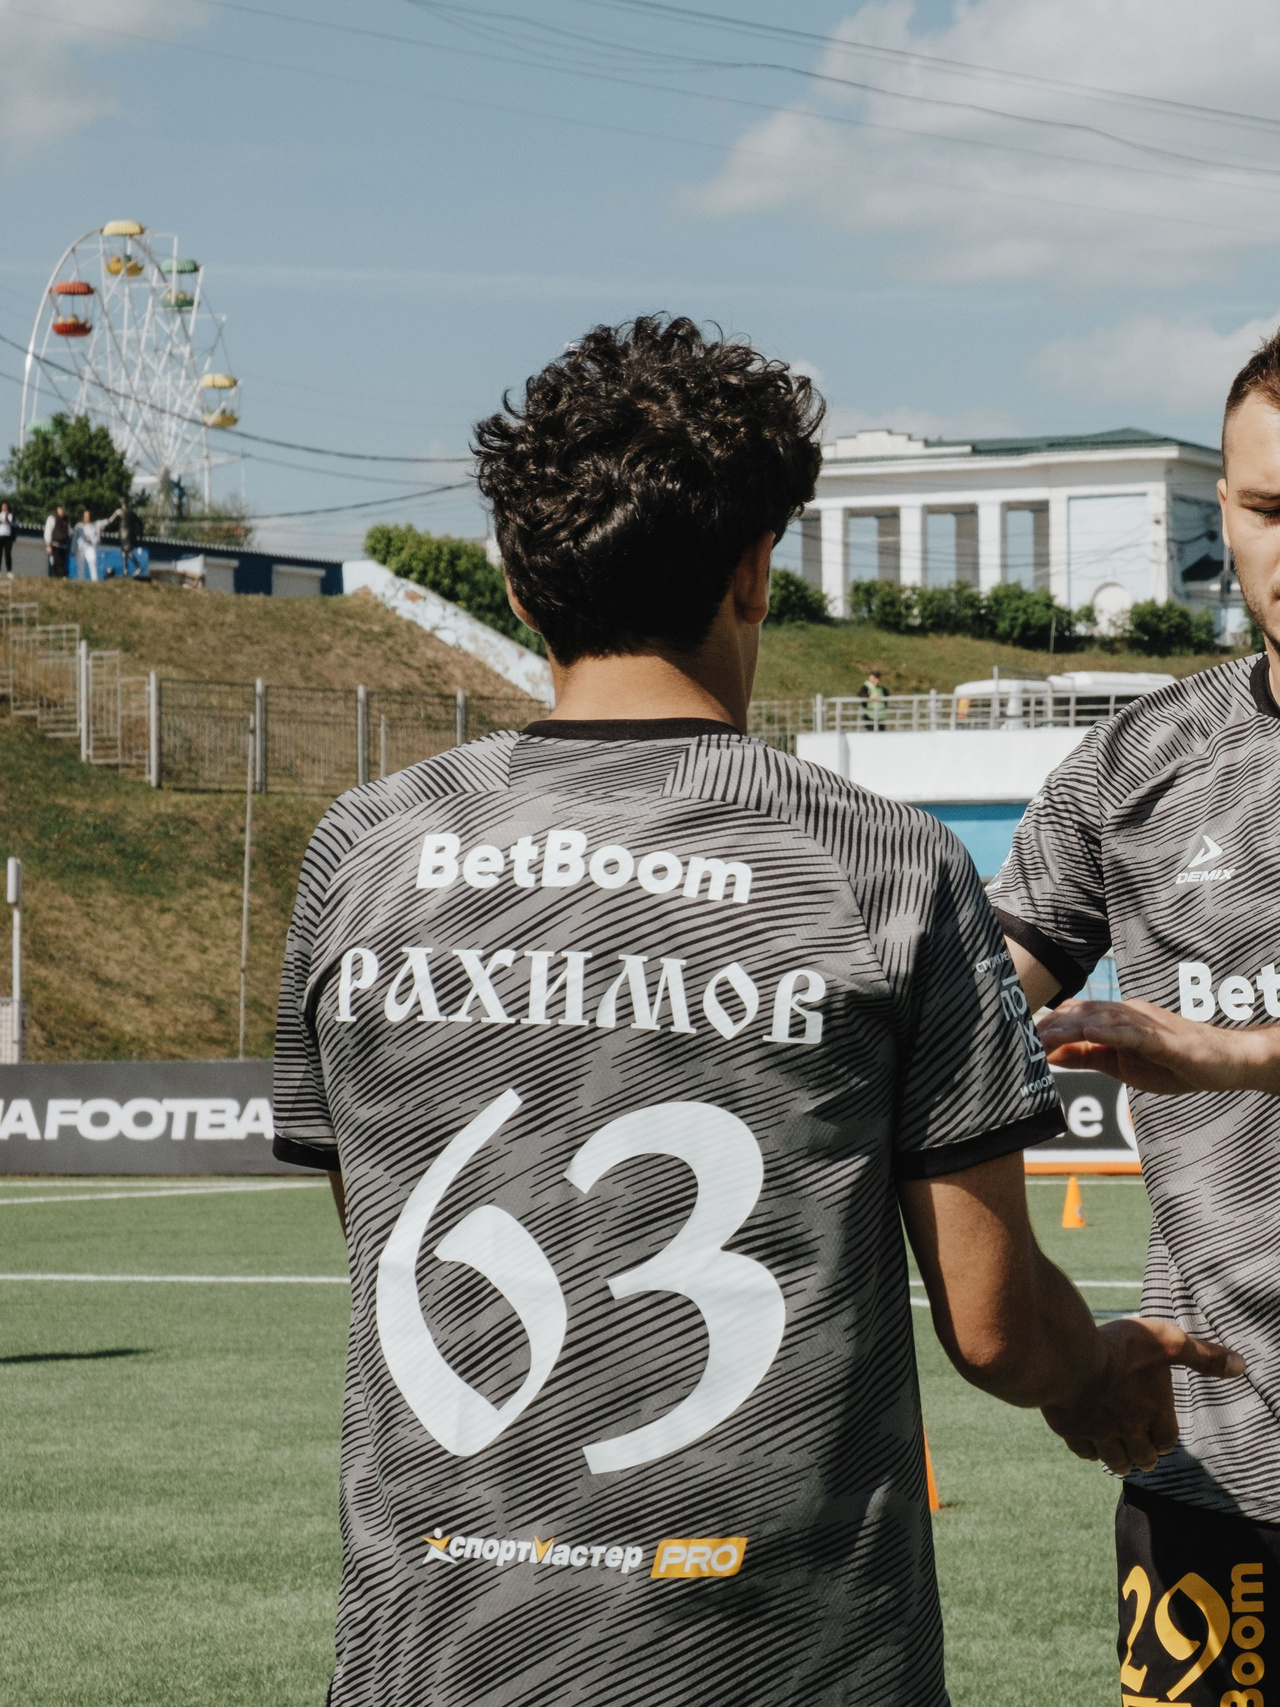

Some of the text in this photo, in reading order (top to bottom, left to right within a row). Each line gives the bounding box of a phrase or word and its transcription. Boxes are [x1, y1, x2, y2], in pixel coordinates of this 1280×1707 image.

[415, 829, 753, 904] BetBoom
[1175, 868, 1236, 885] DEMIX
[335, 946, 828, 1045] РАХИМОВ
[0, 1097, 275, 1141] A FOOTBA
[376, 1088, 786, 1475] 63
[659, 1544, 739, 1574] PRO
[1121, 1565, 1231, 1702] 29
